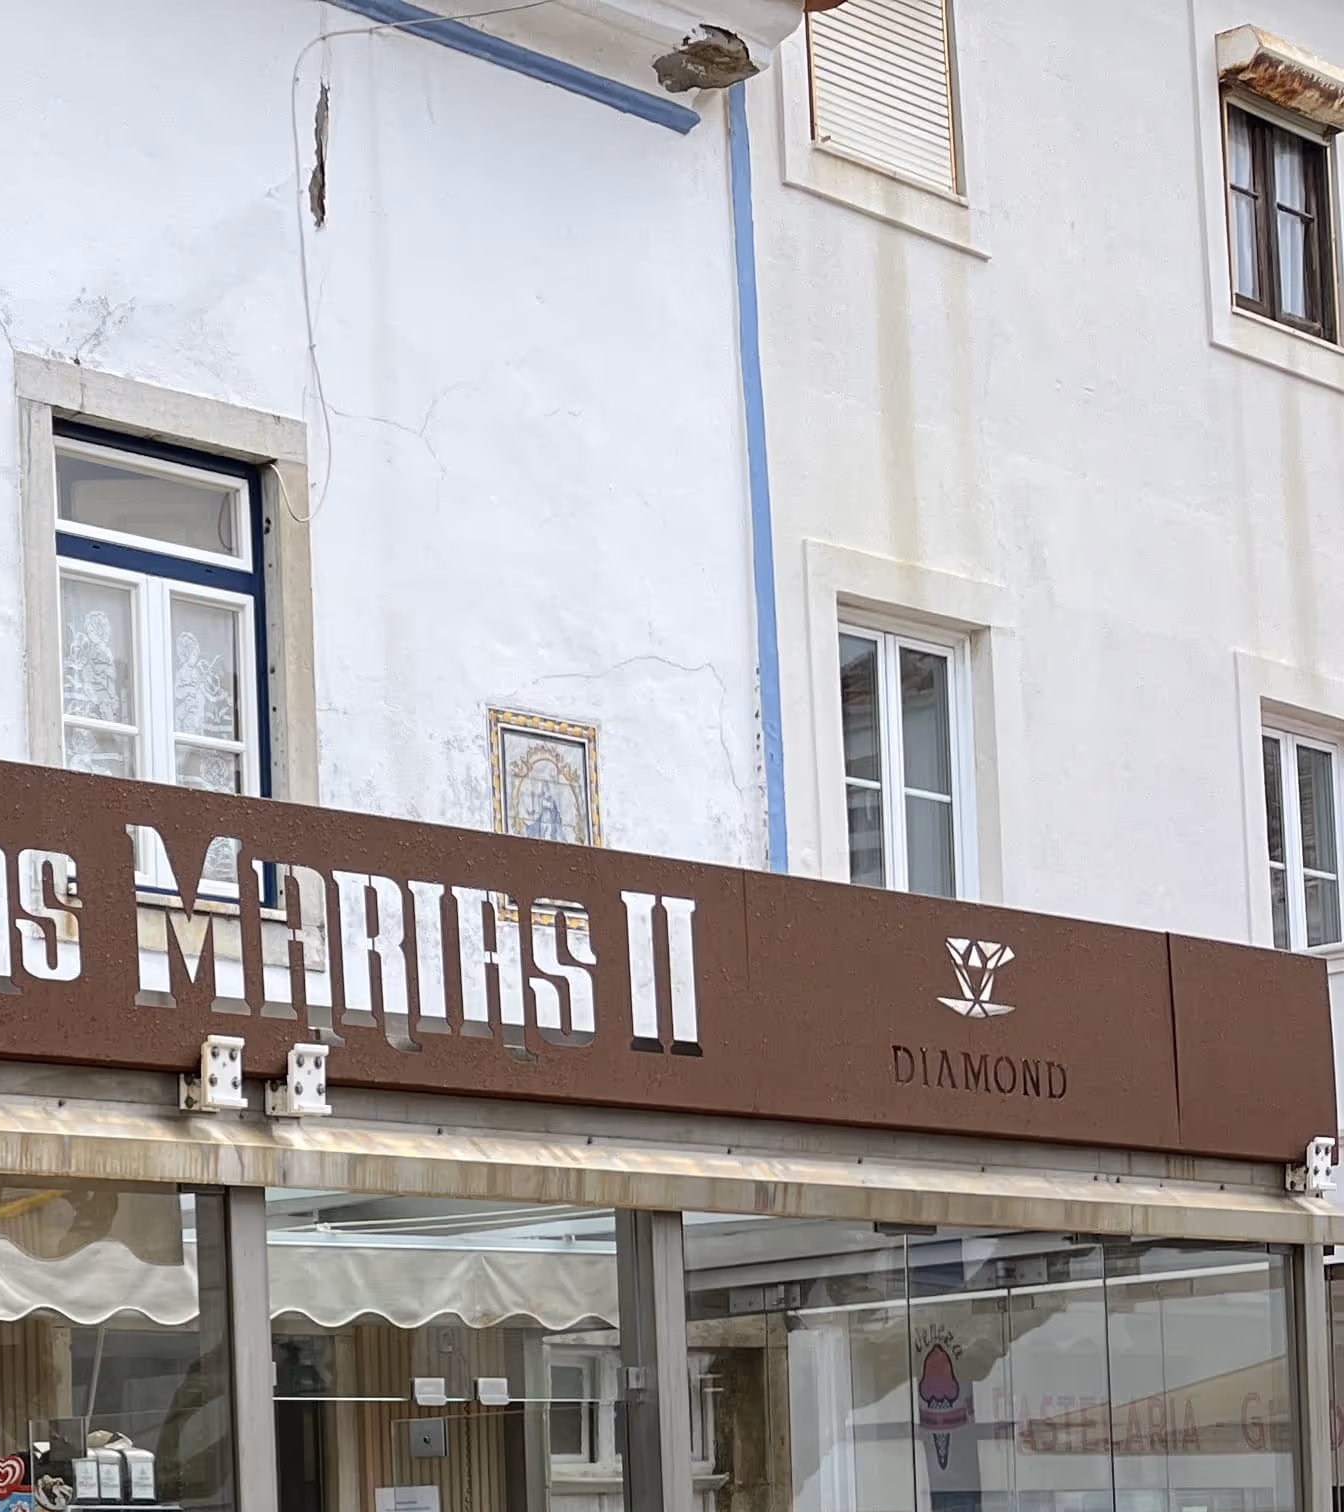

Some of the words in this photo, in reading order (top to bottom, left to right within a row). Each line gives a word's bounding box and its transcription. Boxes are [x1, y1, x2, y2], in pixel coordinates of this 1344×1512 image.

[125, 823, 598, 1063] MARIAS
[620, 890, 704, 1057] II
[891, 1044, 1068, 1101] DIAMOND
